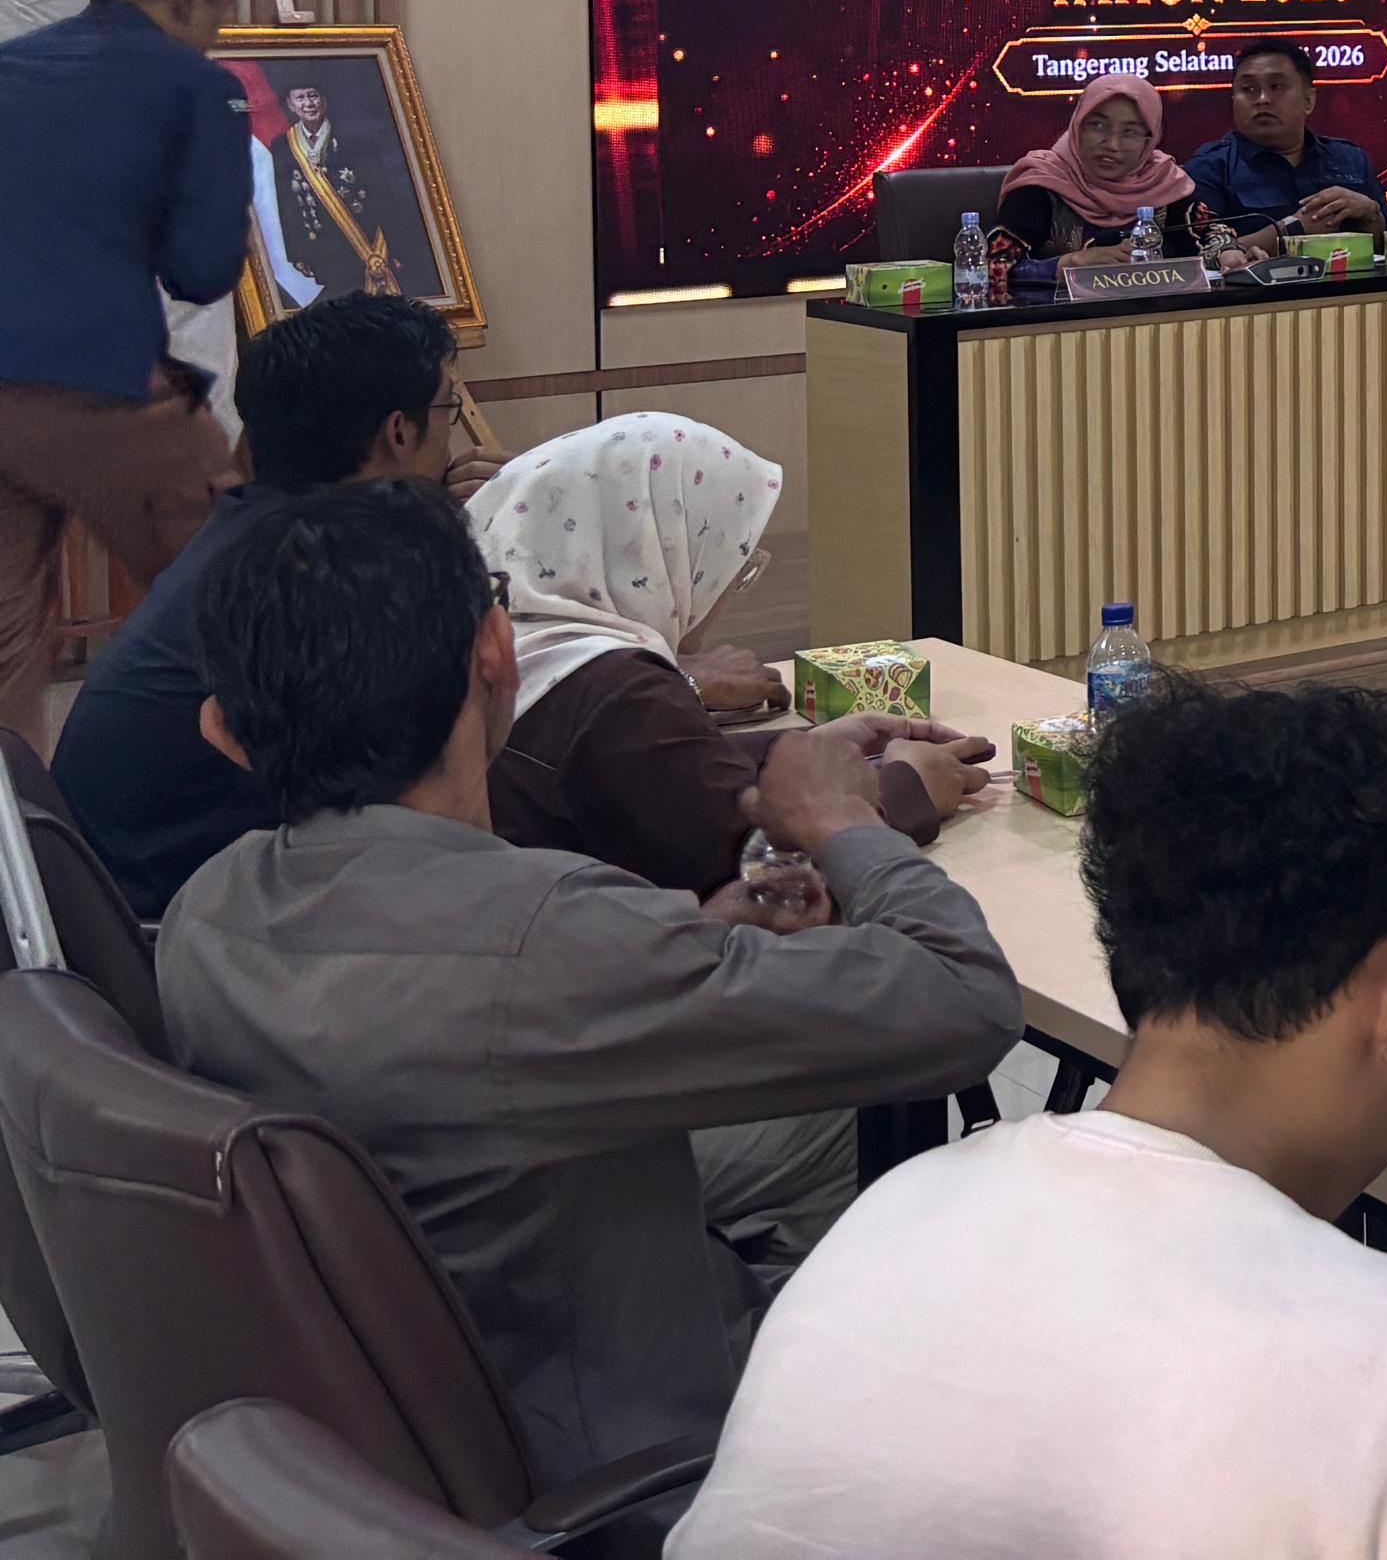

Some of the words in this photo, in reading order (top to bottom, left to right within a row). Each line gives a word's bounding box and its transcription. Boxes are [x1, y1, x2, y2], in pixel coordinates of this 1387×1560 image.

[1032, 53, 1150, 81] Tangerang
[1155, 48, 1234, 73] Selatan
[1315, 45, 1365, 67] 2026
[1092, 269, 1185, 289] ANGGOTA
